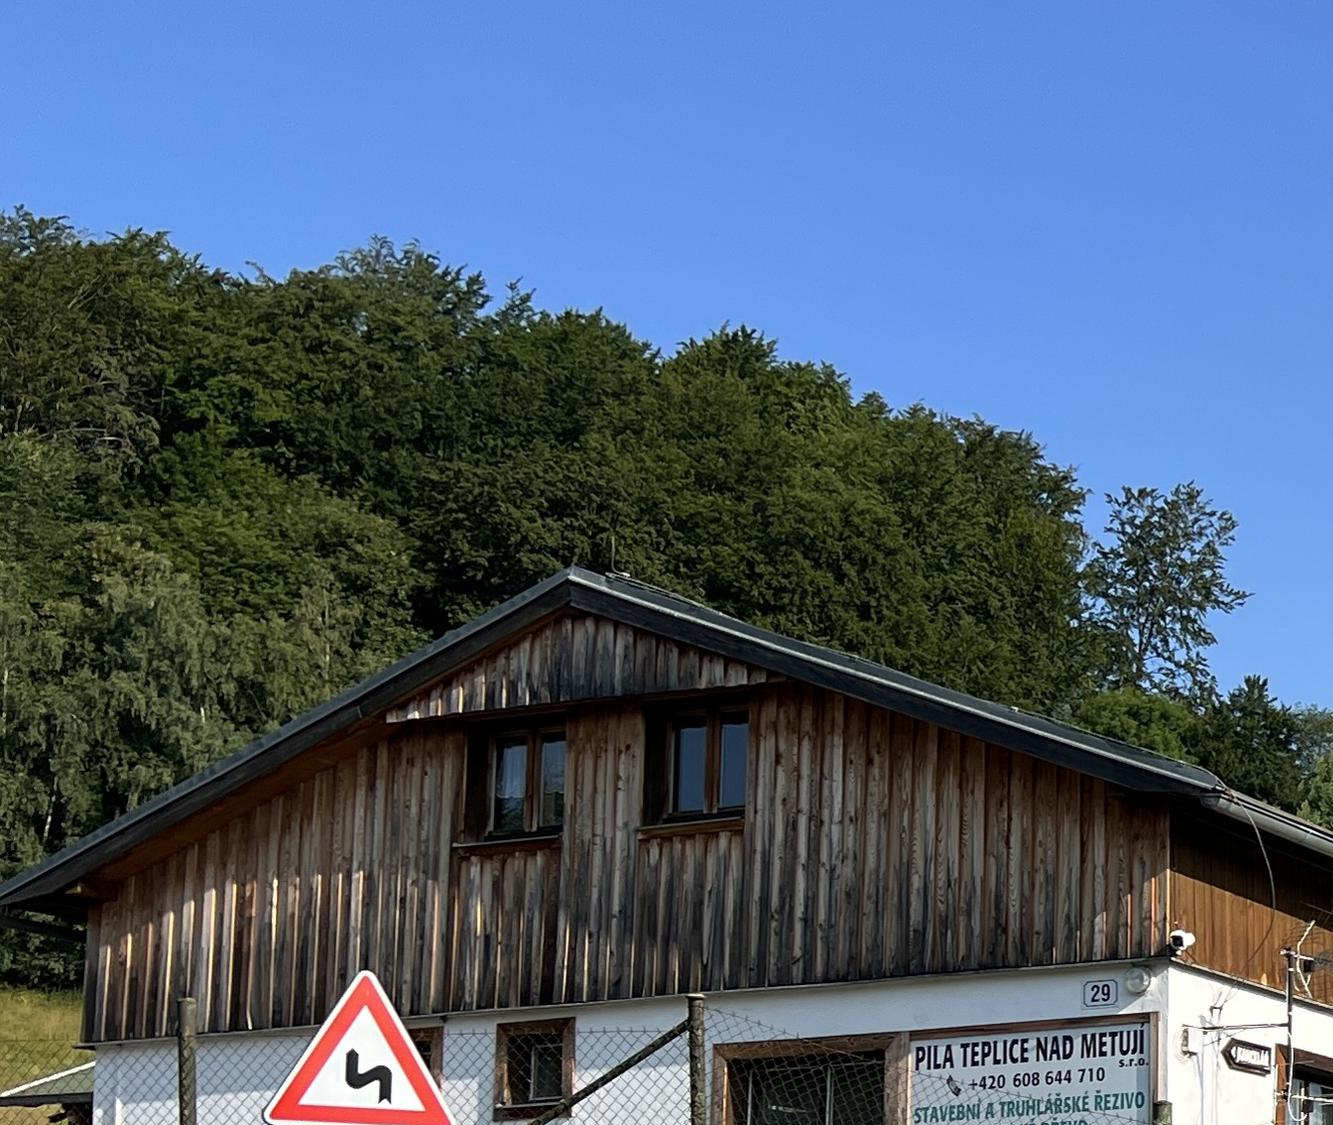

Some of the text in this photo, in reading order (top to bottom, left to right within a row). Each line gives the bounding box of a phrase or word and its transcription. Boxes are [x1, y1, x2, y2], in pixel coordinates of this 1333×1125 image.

[1090, 984, 1111, 1003] 29
[914, 1022, 1145, 1071] PILA TEPLICE NAD METUJÍ
[1118, 1057, 1149, 1068] s.r.o.
[968, 1066, 1106, 1091] +420 608 644 710
[914, 1089, 1145, 1124] STAVEBNÍ A TRUHLÁŘSKÉ ŘEZIVO
